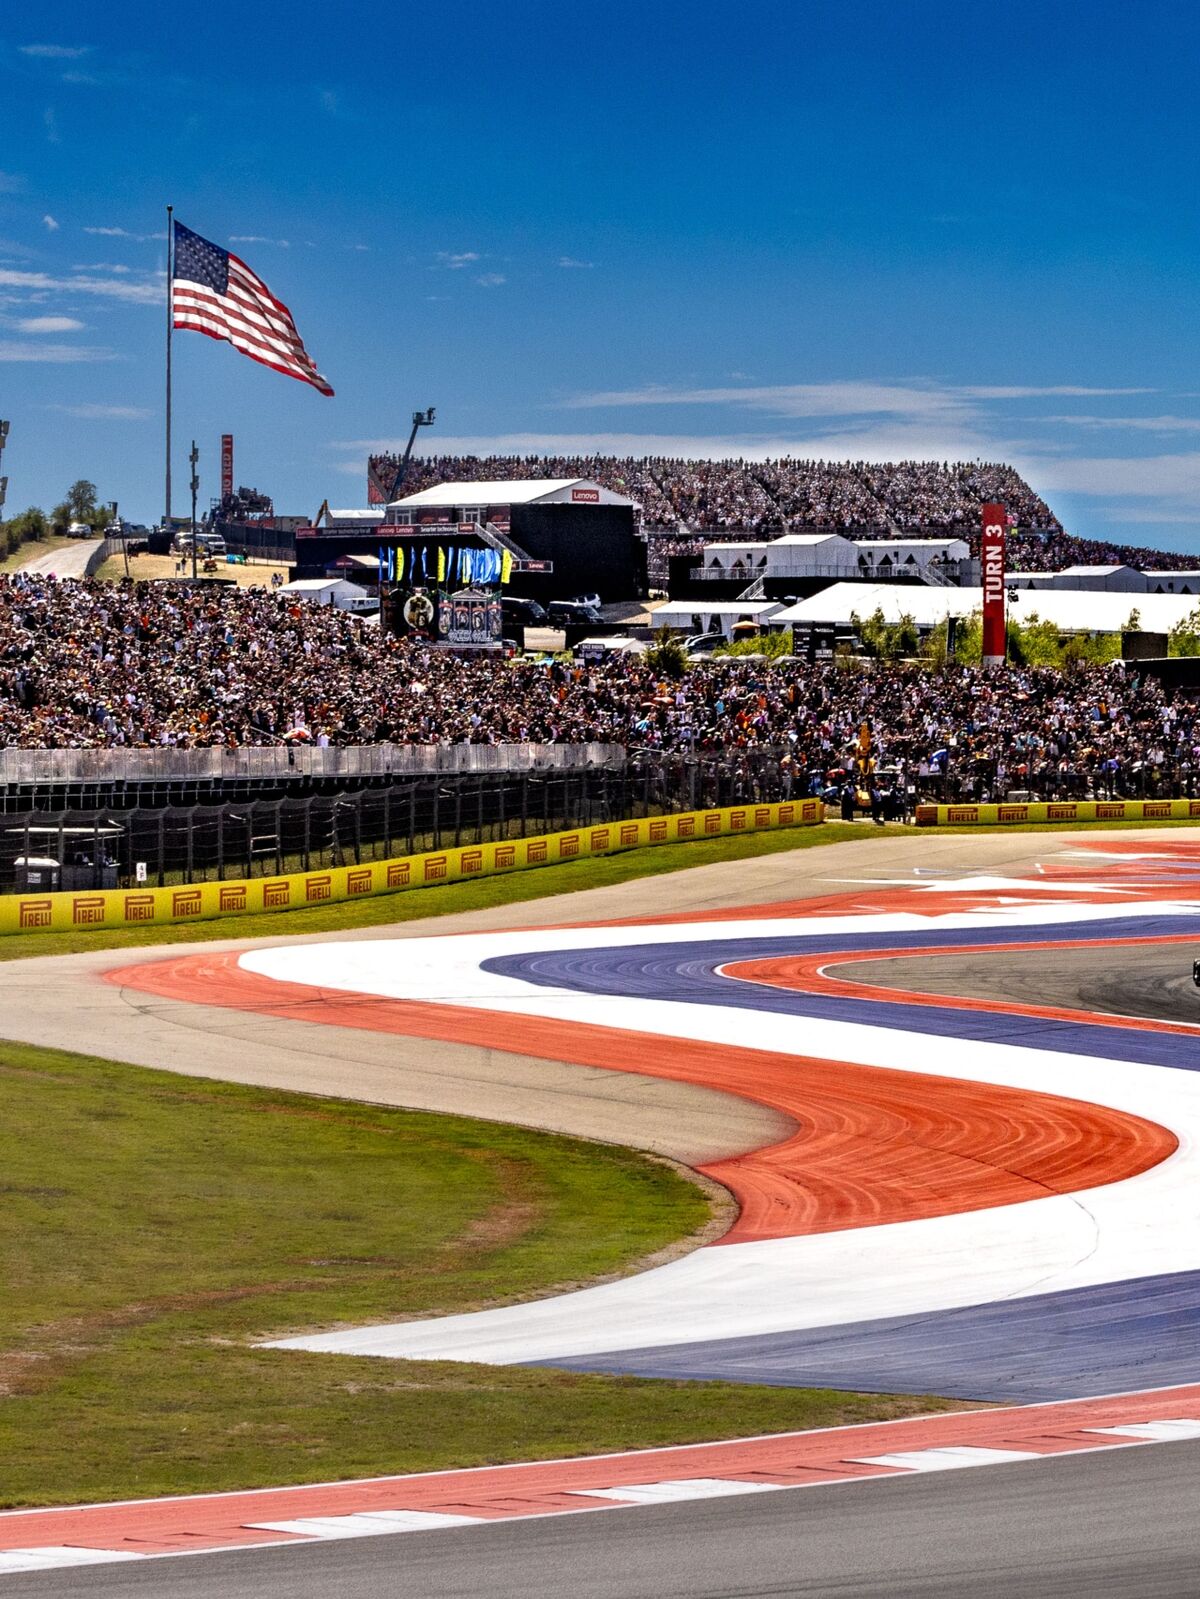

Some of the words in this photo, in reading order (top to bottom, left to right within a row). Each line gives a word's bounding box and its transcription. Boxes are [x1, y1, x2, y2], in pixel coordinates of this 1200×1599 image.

[223, 453, 232, 475] RED
[573, 492, 598, 500] Lenovo
[985, 524, 1003, 538] 3
[985, 545, 1003, 604] TURN
[756, 808, 770, 826] PIRELLI
[779, 806, 793, 824] PIRELLI
[803, 803, 817, 821] PIRELLI
[948, 808, 978, 822] PIRELLI
[998, 806, 1028, 821] PIRELLI
[1048, 805, 1077, 819] PIRELLI
[1096, 803, 1125, 818] PIRELLI
[1143, 802, 1171, 816] PIRELLI
[650, 821, 667, 841] PIRELLI
[678, 816, 695, 836] PIRELLI
[705, 813, 721, 833] PIRELLI
[731, 812, 746, 830] PIRELLI
[560, 834, 579, 856] PIRELLI
[592, 829, 609, 850] PIRELLI
[621, 824, 639, 845] PIRELLI
[461, 850, 481, 873] PIRELLI
[495, 846, 515, 868] PIRELLI
[527, 841, 547, 864] PIRELLI
[387, 863, 410, 886] PIRELLI
[425, 856, 446, 880] PIRELLI
[306, 875, 331, 900] PIRELLI
[348, 869, 372, 894] PIRELLI
[173, 891, 201, 917] PIRELLI
[220, 886, 246, 912] PIRELLI
[264, 882, 289, 907] PIRELLI
[20, 901, 52, 926] PIRELLI
[73, 897, 105, 923] PIRELLI
[125, 895, 154, 920] PIRELLI
